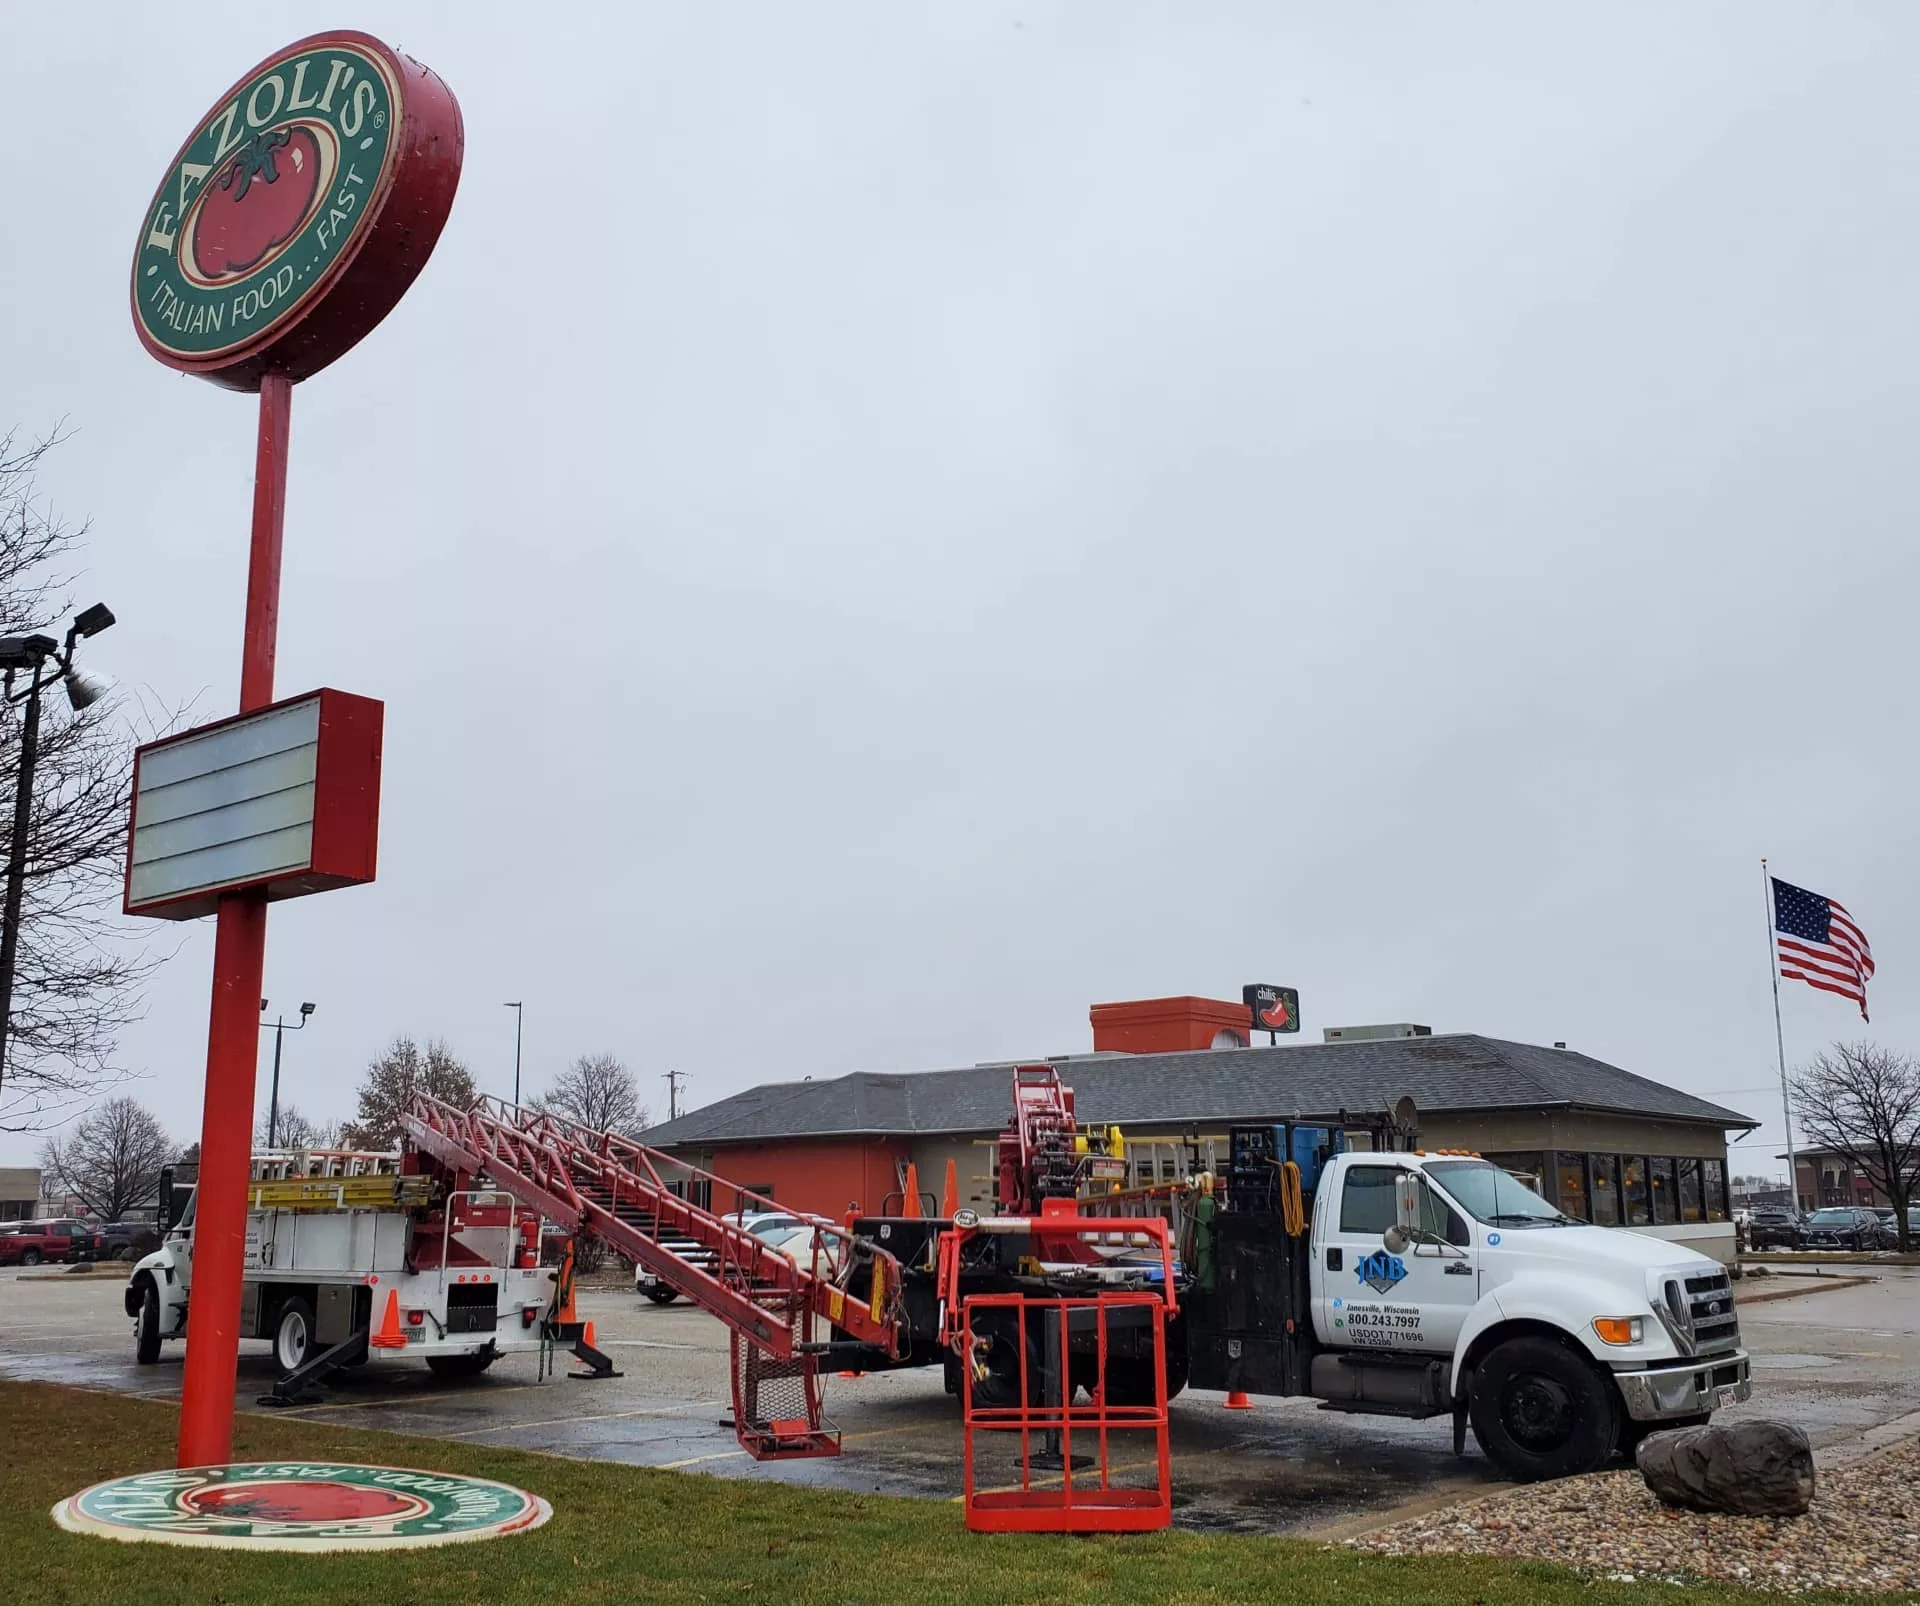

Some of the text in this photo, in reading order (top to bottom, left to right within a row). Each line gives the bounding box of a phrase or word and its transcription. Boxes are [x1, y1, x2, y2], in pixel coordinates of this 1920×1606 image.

[147, 60, 376, 256] FAZOLI'S
[151, 279, 225, 335] ITALIAN
[315, 163, 364, 250] FAST
[1358, 1255, 1404, 1285] JNB
[1348, 1313, 1421, 1328] 800.243.7997
[1384, 1305, 1420, 1315] Wisconsin
[1349, 1328, 1385, 1340] USDOT
